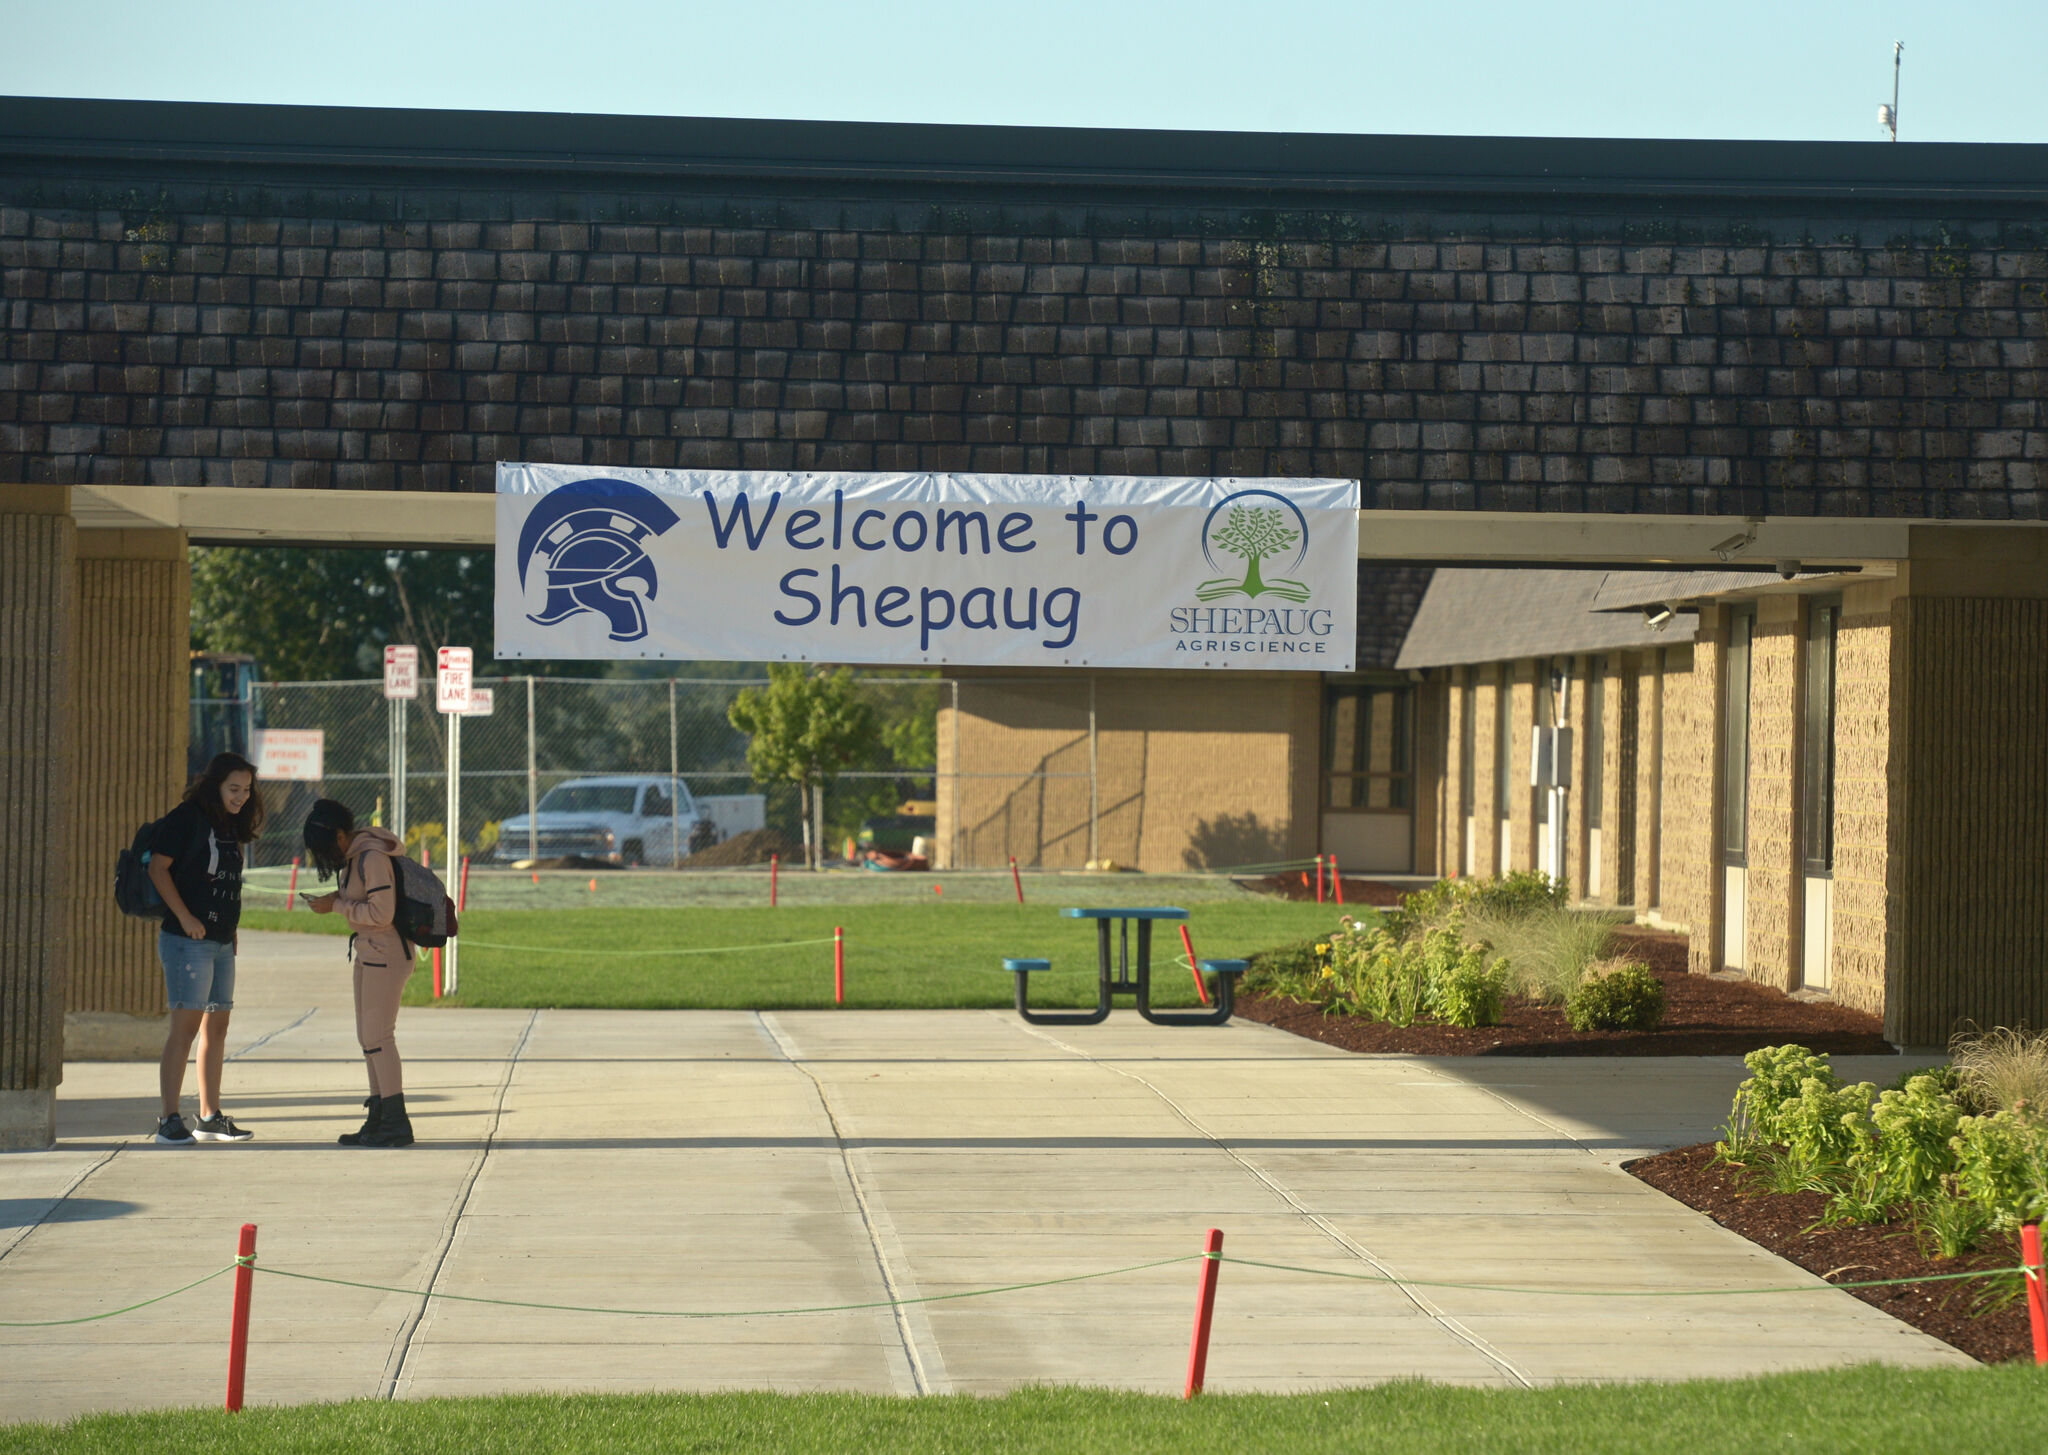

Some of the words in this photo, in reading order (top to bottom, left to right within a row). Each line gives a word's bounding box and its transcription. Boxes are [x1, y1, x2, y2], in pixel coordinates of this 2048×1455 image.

[703, 489, 1037, 555] Welcome
[1065, 500, 1138, 555] to
[773, 563, 1081, 651] Shepaug
[1170, 607, 1334, 636] SHEPAUG
[1175, 640, 1326, 653] AGRISCIENCE
[391, 665, 410, 676] FIRE
[389, 679, 412, 690] LANE
[444, 672, 464, 685] FIRE
[442, 688, 466, 701] LANE
